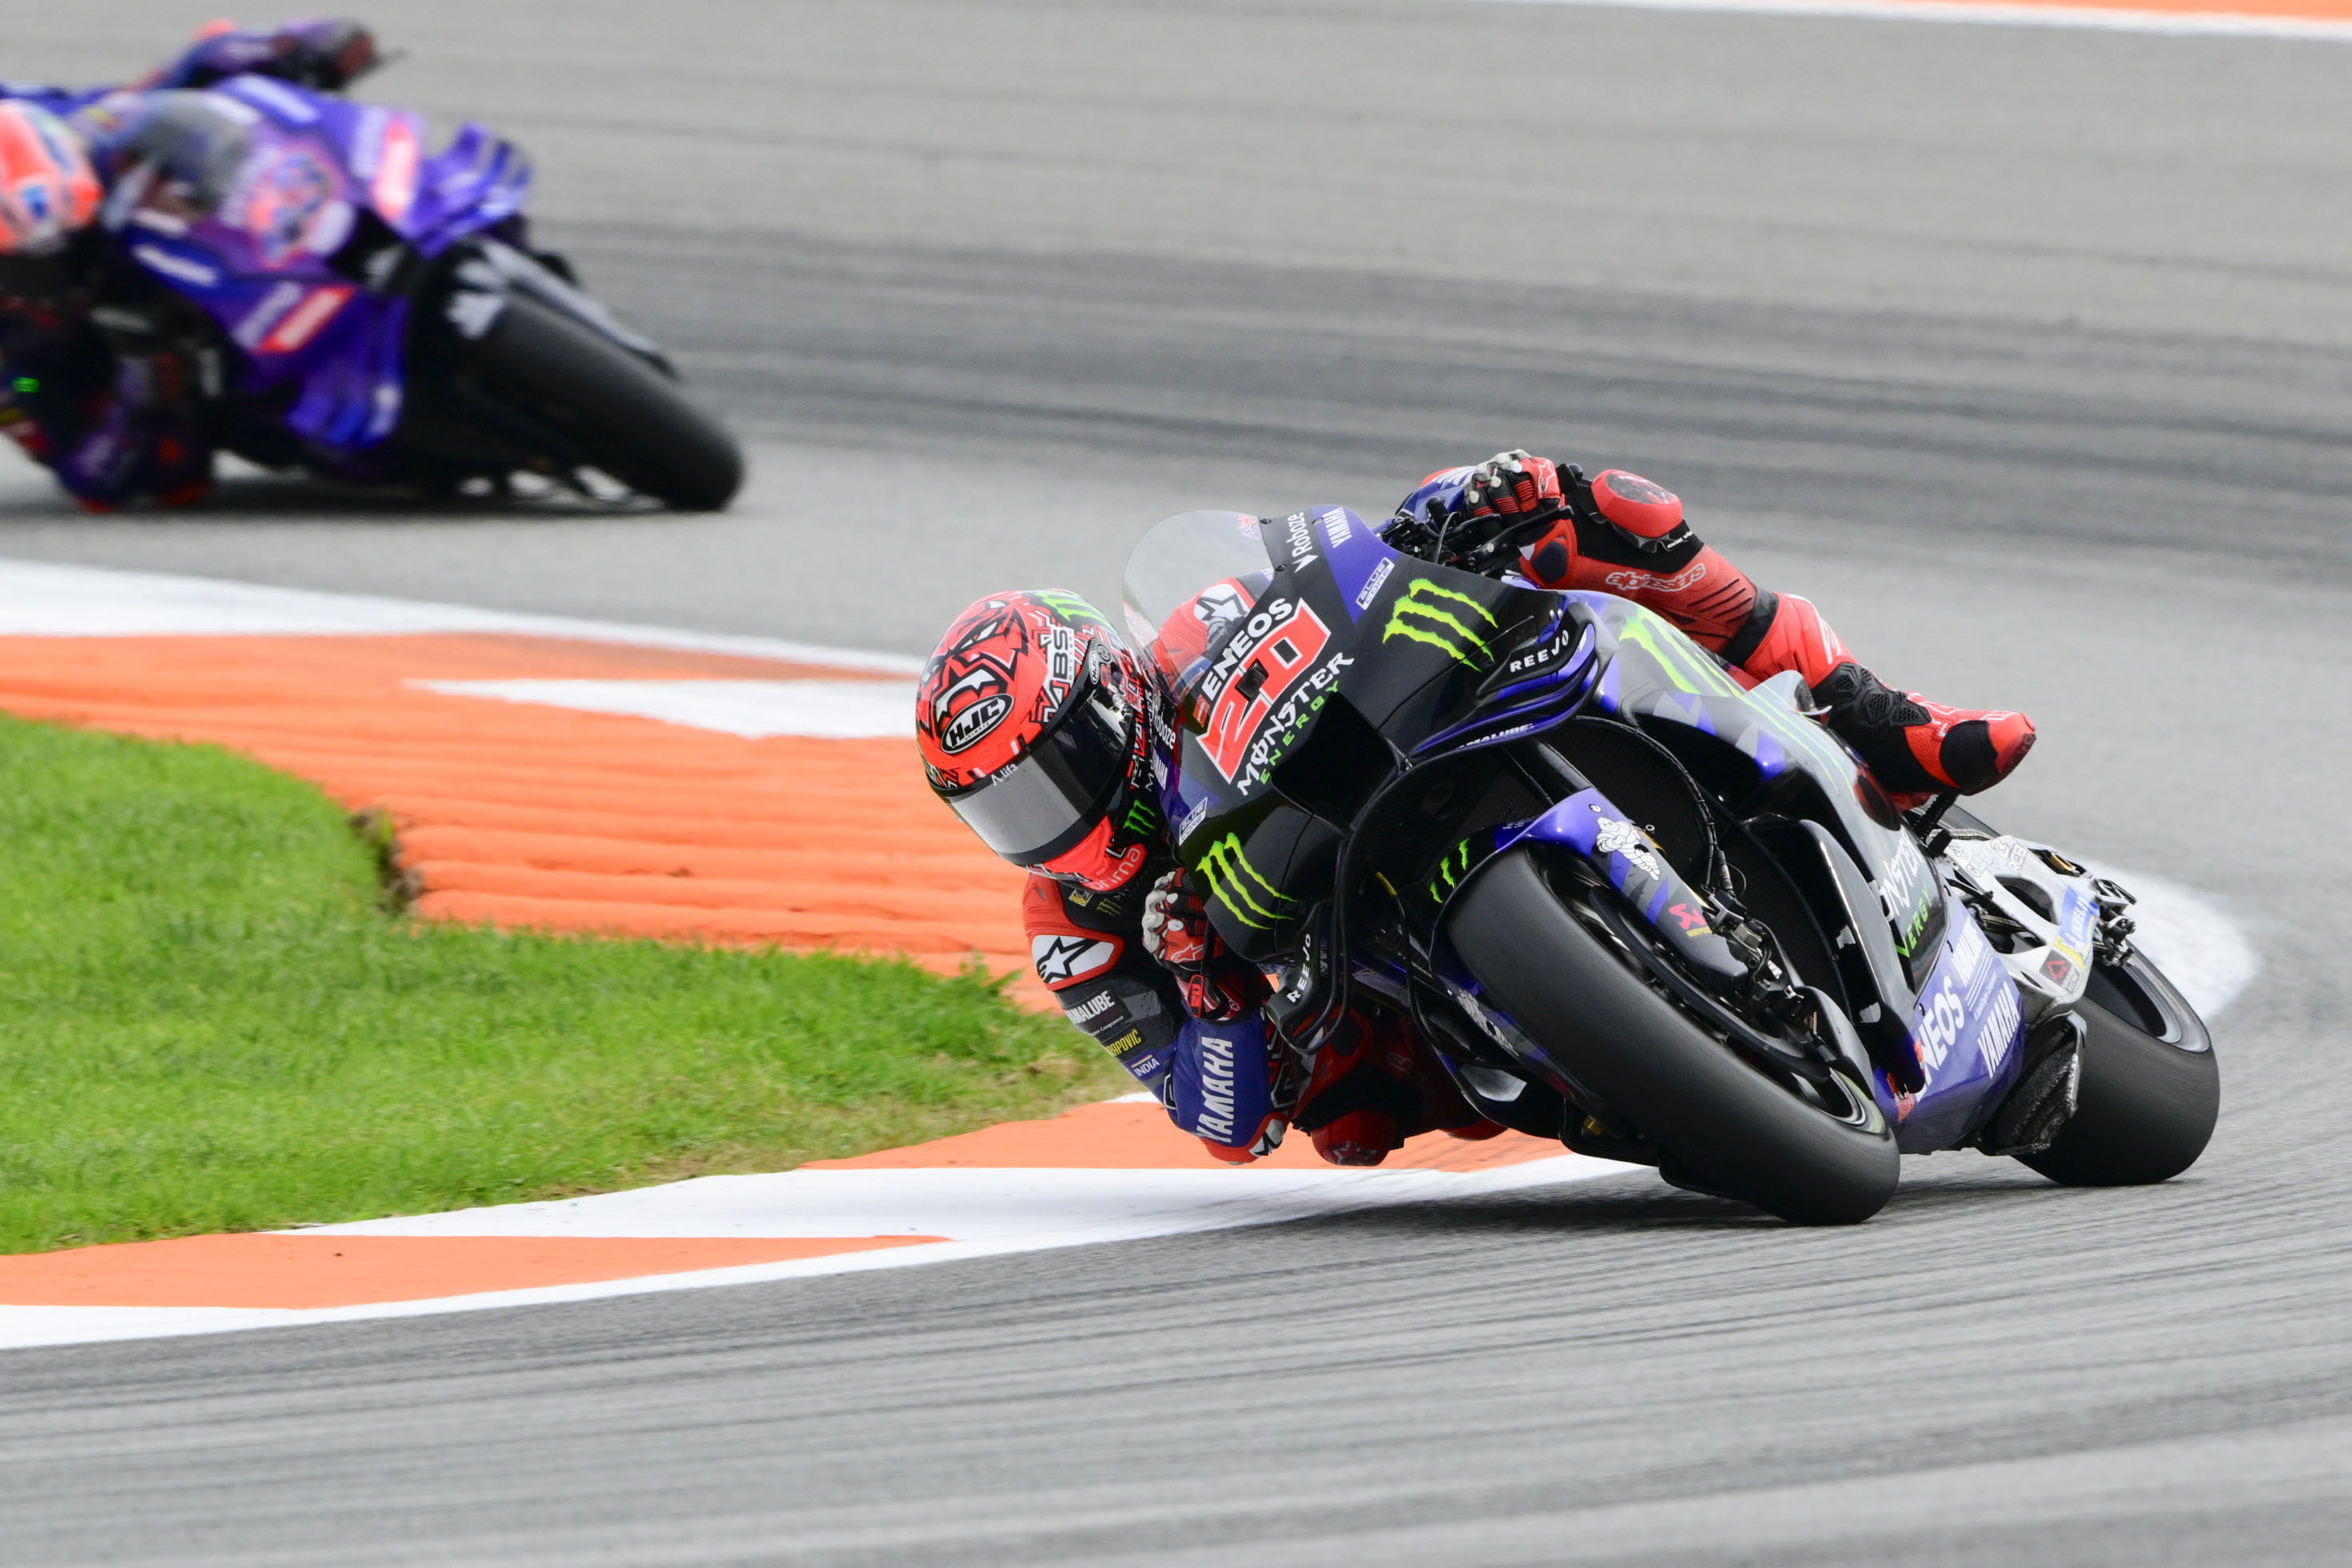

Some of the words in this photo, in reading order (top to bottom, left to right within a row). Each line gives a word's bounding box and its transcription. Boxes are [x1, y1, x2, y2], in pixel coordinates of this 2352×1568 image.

[1286, 511, 1313, 557] Roboze
[1322, 507, 1352, 549] YAMAHA
[1196, 597, 1331, 786] 20
[1202, 597, 1293, 701] ENEOS
[1509, 630, 1570, 673] REEVO
[949, 698, 1001, 749] HJC
[1237, 651, 1355, 796] MONSTER
[1259, 680, 1339, 786] ENERGY
[1287, 933, 1311, 1004] REEVO
[1133, 1057, 1160, 1077] INDIA
[1977, 980, 2020, 1080] YAMAHA
[1196, 1037, 1236, 1144] YAMAHA
